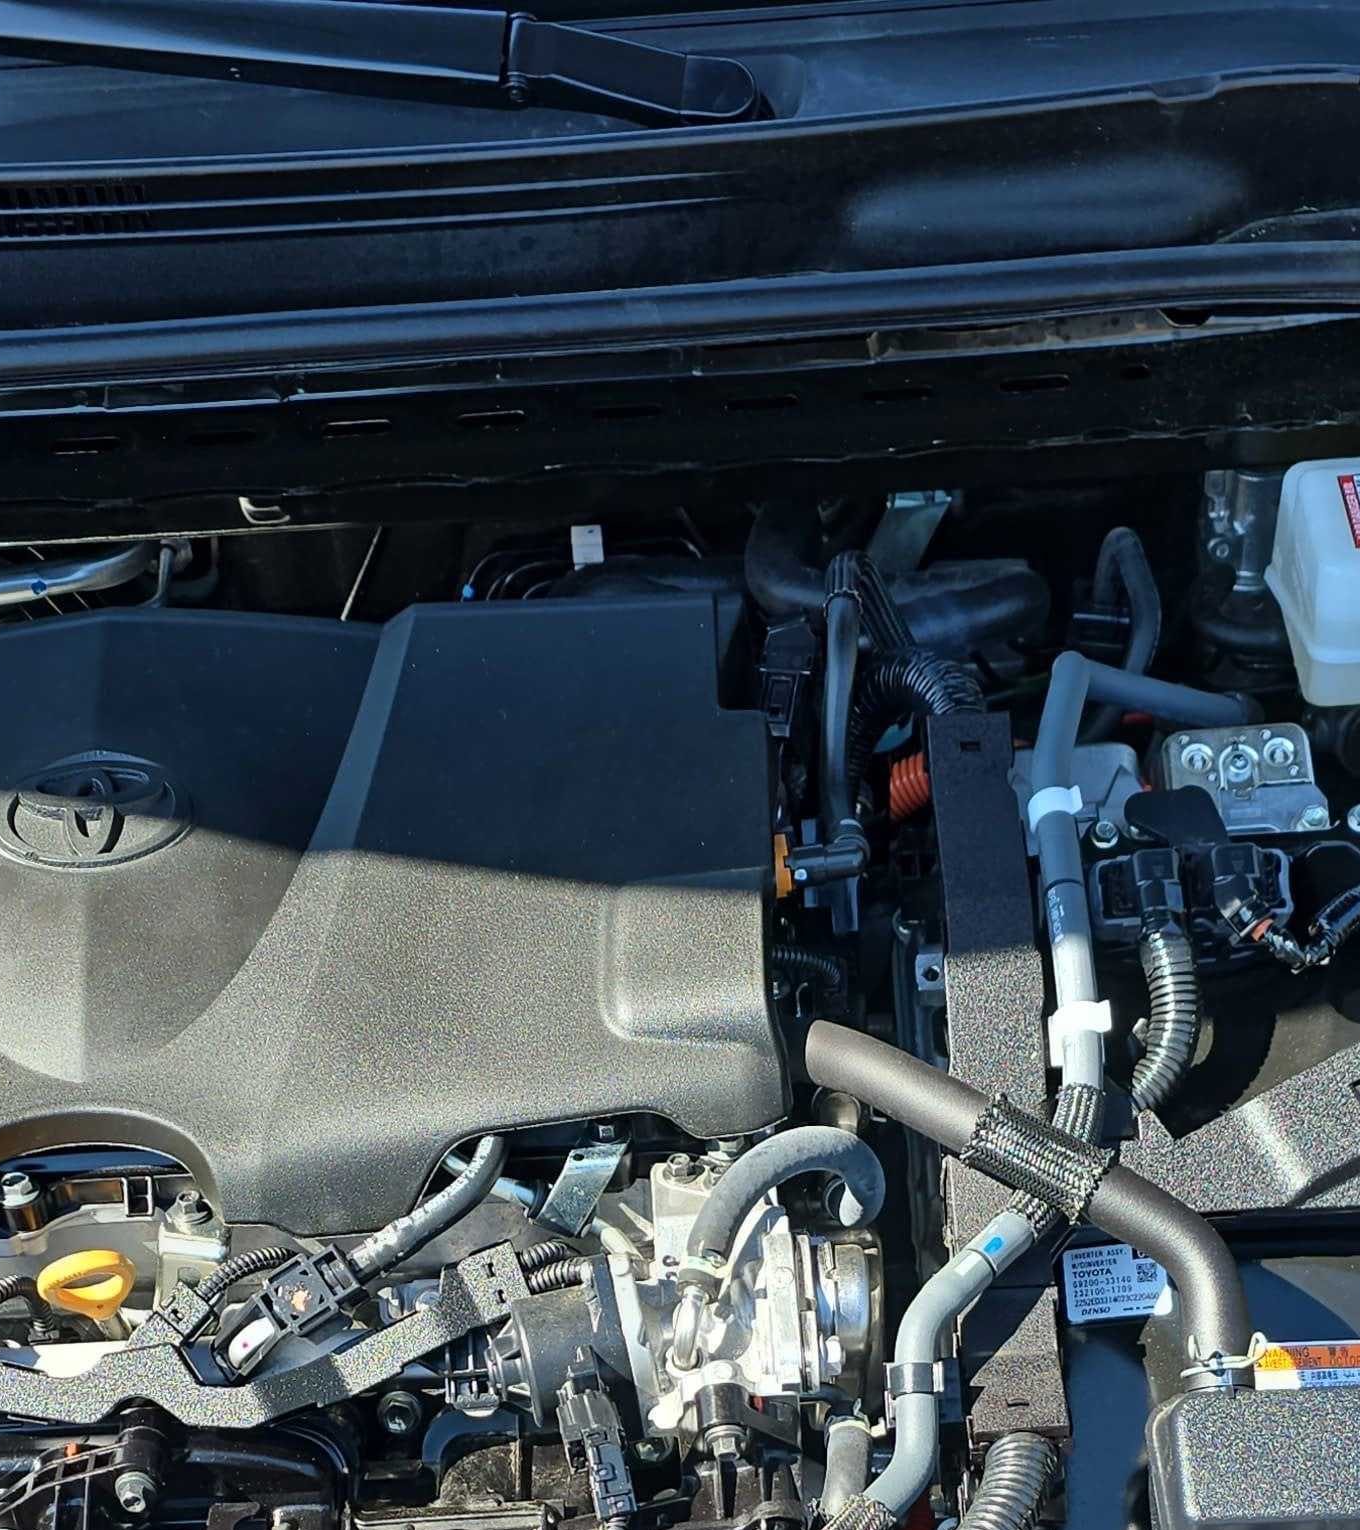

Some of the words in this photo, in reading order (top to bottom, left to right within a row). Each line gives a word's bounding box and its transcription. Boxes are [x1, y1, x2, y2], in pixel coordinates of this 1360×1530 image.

[1071, 1250, 1103, 1260] INVERTER
[1072, 1268, 1113, 1279] TOYOTA
[1081, 1306, 1111, 1316] DENSO
